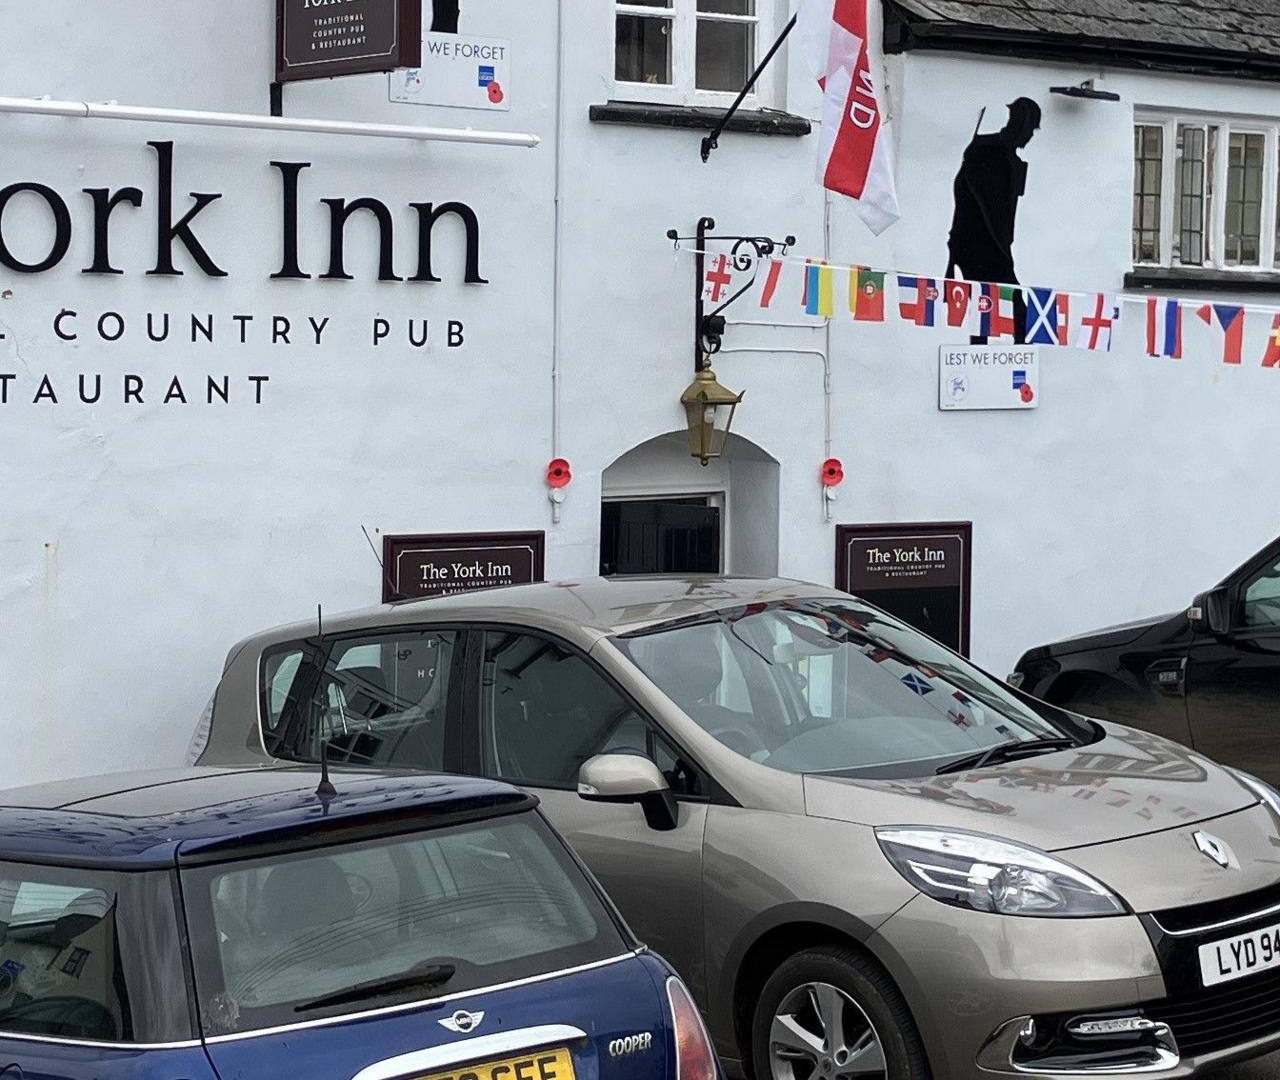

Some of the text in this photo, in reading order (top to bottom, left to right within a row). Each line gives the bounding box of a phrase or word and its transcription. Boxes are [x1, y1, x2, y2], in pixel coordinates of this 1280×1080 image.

[314, 13, 364, 26] TRADITIONAL
[313, 24, 364, 38] COUNTRY PUB
[319, 36, 366, 49] RESTAURANT
[428, 40, 505, 60] WE FORGET
[269, 160, 489, 284] Inn
[53, 309, 330, 345] COUNTRY
[373, 318, 465, 348] PUB
[945, 352, 1034, 365] LEST WE FORGET
[866, 546, 945, 563] The York Inn
[420, 560, 511, 580] The York Inn
[1216, 937, 1257, 975] LYD
[609, 1031, 652, 1057] COOPER
